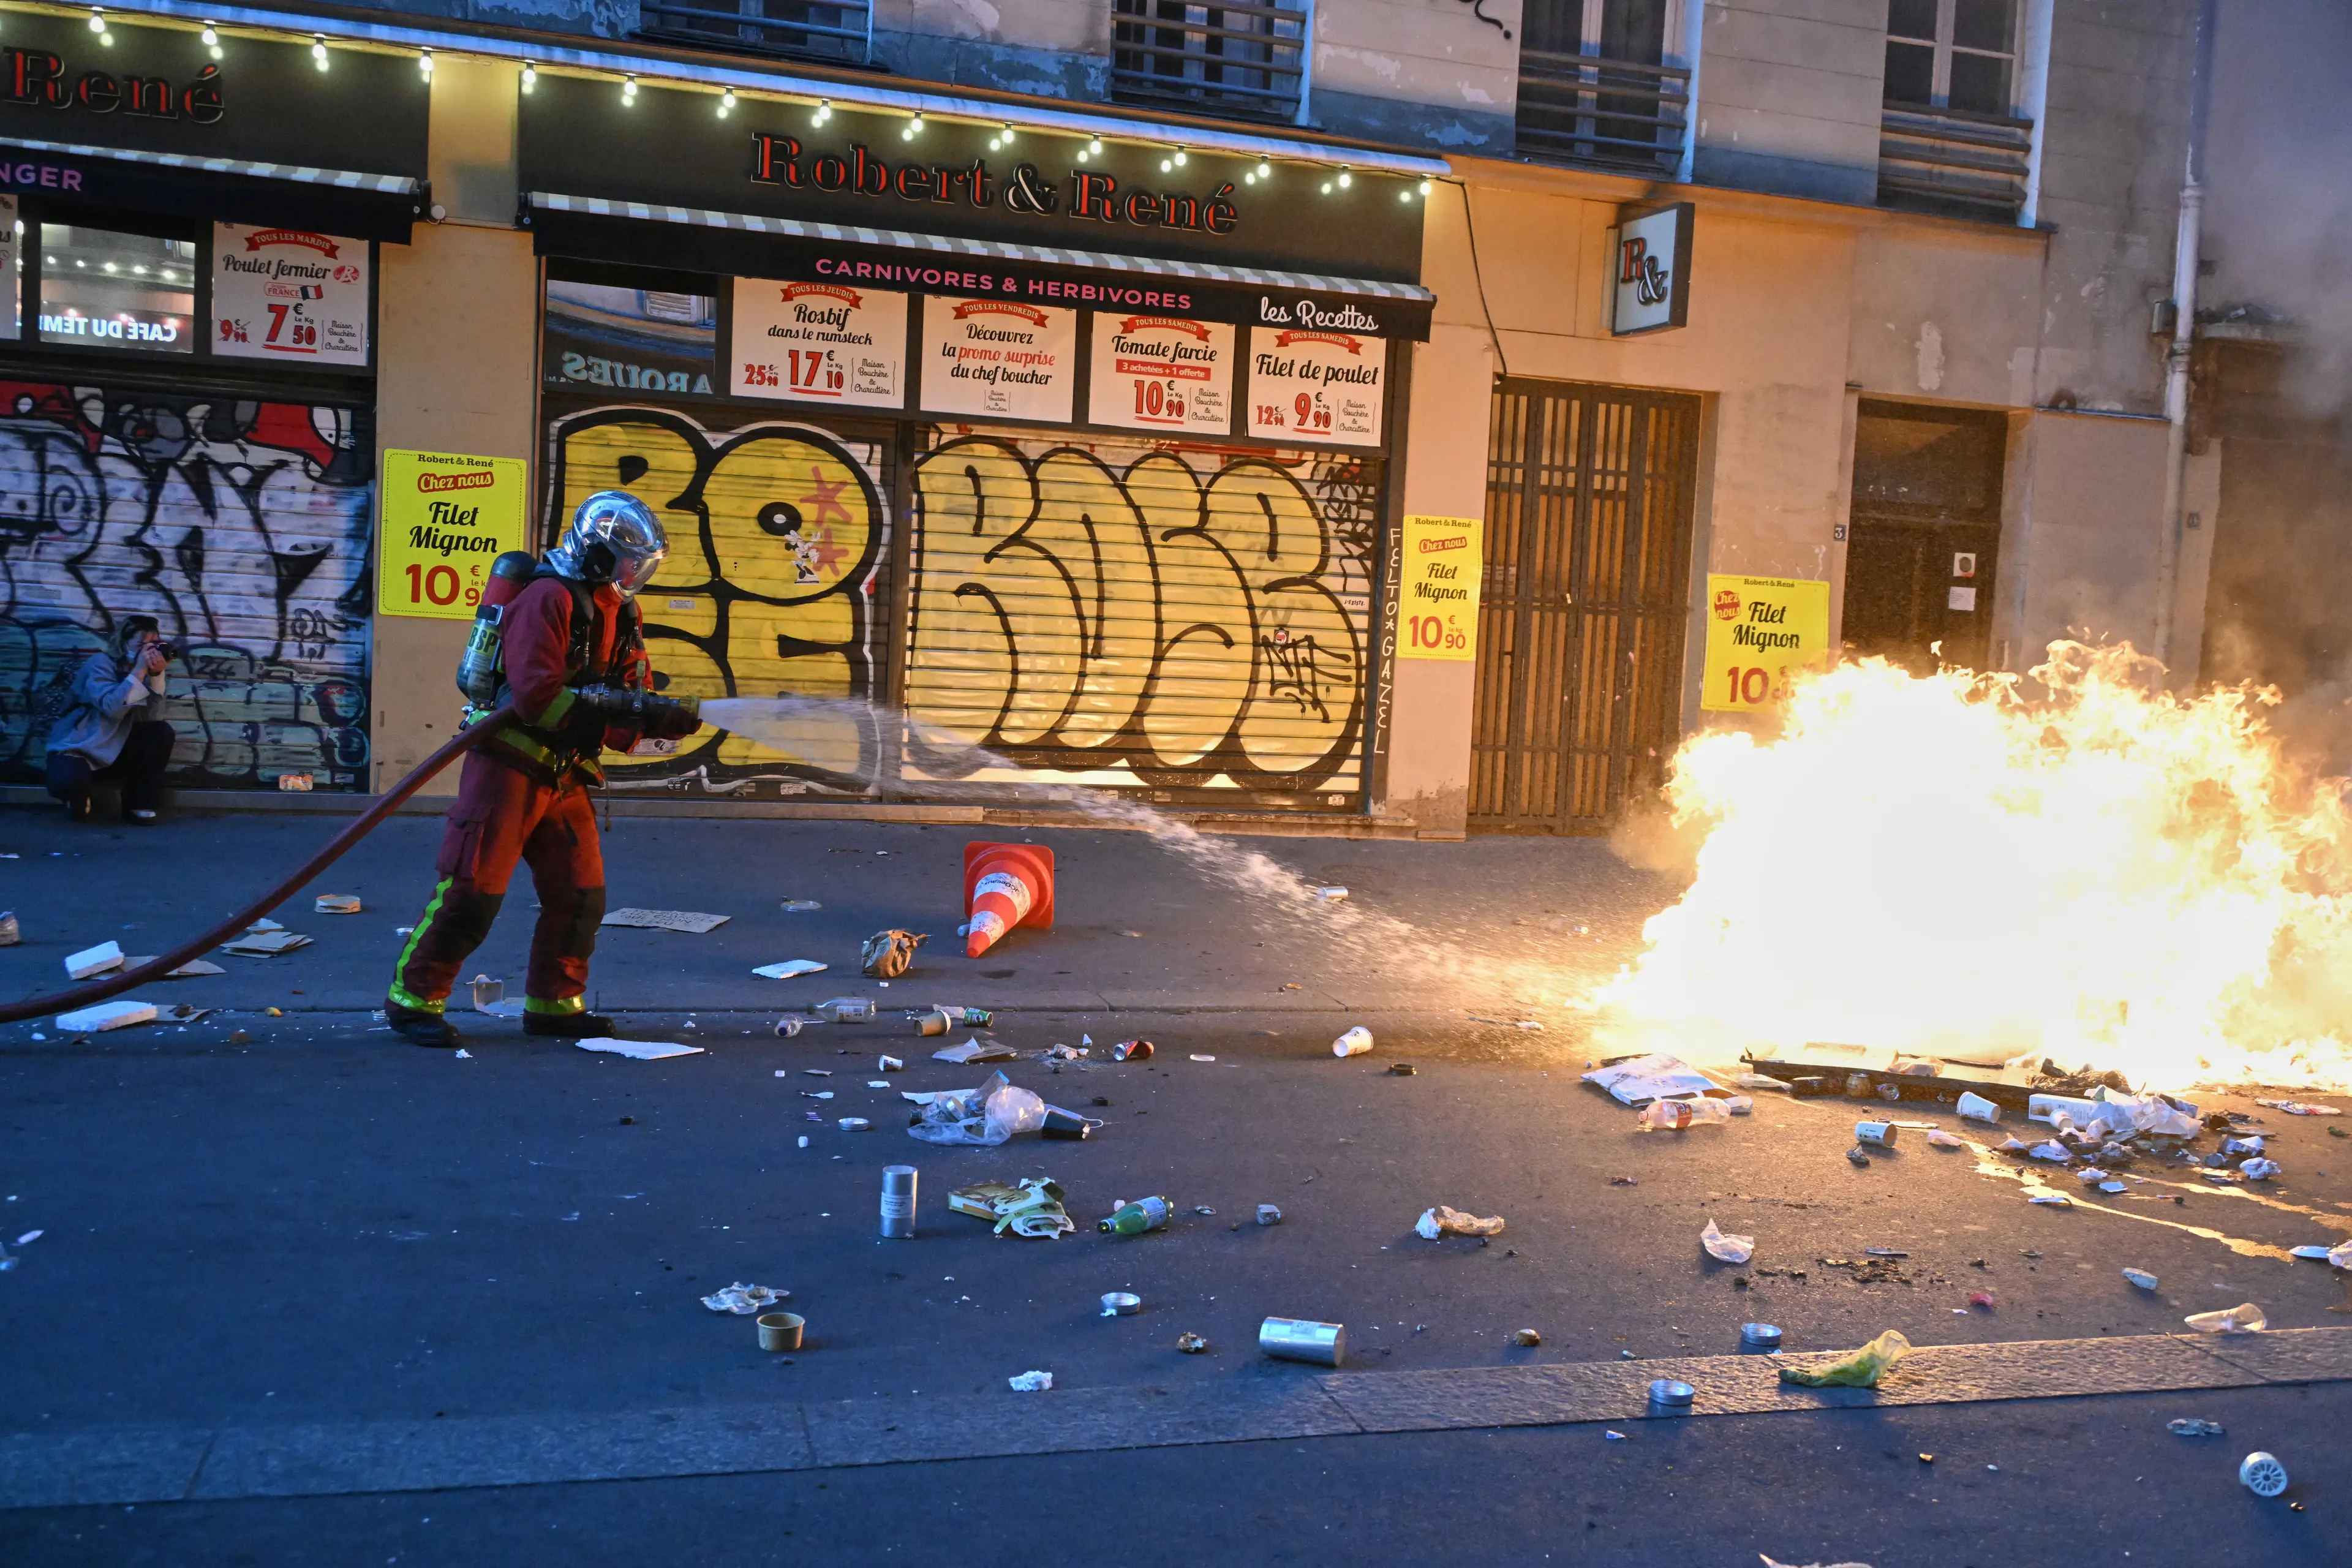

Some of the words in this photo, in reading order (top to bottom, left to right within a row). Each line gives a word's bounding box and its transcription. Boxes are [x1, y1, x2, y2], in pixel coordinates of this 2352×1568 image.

[2, 46, 224, 123] René
[750, 132, 993, 208] Robert
[1005, 164, 1058, 214] &
[1070, 168, 1238, 235] René
[255, 233, 277, 243] TOUS
[296, 235, 331, 249] MARDIS
[223, 255, 272, 274] Poulet
[272, 260, 331, 280] fermier
[268, 288, 300, 296] FRANCE
[815, 258, 993, 290] CARNIVORES
[1002, 277, 1018, 293] &
[1028, 280, 1191, 309] HERBIVORES
[791, 285, 810, 295] TOUS
[827, 286, 854, 300] JEUDIS
[794, 303, 852, 331] Rosbif
[998, 304, 1038, 318] VENDREDIS
[1261, 296, 1292, 322] les
[1296, 300, 1378, 331] Recettes
[266, 304, 289, 342] 7
[293, 303, 303, 315] €
[332, 321, 353, 330] Maison
[1168, 319, 1197, 331] SAMEDIS
[293, 325, 316, 345] 50
[328, 328, 356, 337] Bouchère
[767, 325, 799, 339] dans
[802, 328, 812, 340] le
[816, 332, 872, 345] rumsteck
[966, 323, 1034, 344] Découvrez
[1322, 333, 1349, 345] SAMEDIS
[942, 342, 956, 357] la
[957, 346, 1001, 363] promo
[1005, 350, 1055, 368] surprise
[1112, 336, 1170, 357] Tomate
[1169, 342, 1217, 363] farcie
[788, 349, 823, 386] 17
[826, 350, 834, 361] €
[862, 358, 884, 368] Maison
[1130, 364, 1163, 374] achetées
[1179, 368, 1205, 377] offerte
[1256, 353, 1295, 377] Filet
[1299, 360, 1320, 379] de
[1323, 364, 1379, 387] poulet
[745, 364, 766, 385] 25
[767, 376, 778, 386] 90
[827, 371, 843, 389] 10
[858, 368, 888, 378] Bouchère
[951, 364, 968, 379] du
[972, 366, 1001, 385] chef
[1001, 368, 1052, 385] boucher
[854, 384, 891, 394] Charcutière
[1134, 380, 1164, 415] 10
[1166, 380, 1175, 391] €
[1199, 388, 1220, 398] Maison
[1166, 400, 1185, 417] 90
[1194, 396, 1223, 407] Bouchère
[1295, 393, 1311, 426] 9
[1314, 391, 1322, 402] €
[1346, 399, 1366, 409] Maison
[1191, 412, 1224, 423] Charcutière
[1257, 405, 1273, 425] 12
[1274, 415, 1284, 426] 90
[1313, 411, 1331, 428] 90
[1343, 407, 1369, 418] Bouchère
[1339, 423, 1370, 434] Charcutière
[418, 454, 454, 464] Robert
[466, 459, 494, 467] René
[420, 475, 454, 490] Chez
[458, 473, 491, 487] nous
[429, 501, 479, 527] Filet
[1835, 527, 1842, 538] 3
[409, 526, 497, 557] Mignon
[1420, 539, 1443, 552] Chez
[1444, 538, 1466, 548] nous
[1427, 562, 1458, 579] Filet
[405, 564, 460, 605] 10
[470, 565, 480, 576] €
[1414, 582, 1468, 603] Mignon
[464, 587, 483, 606] 9
[1715, 592, 1739, 605] Chez
[1716, 607, 1741, 619] nous
[1749, 601, 1787, 624] Filet
[468, 627, 498, 653] BSP
[1409, 615, 1443, 649] 10
[1448, 615, 1455, 625] €
[1733, 624, 1800, 653] Mignon
[1445, 633, 1466, 650] 90
[1727, 666, 1769, 704] 10
